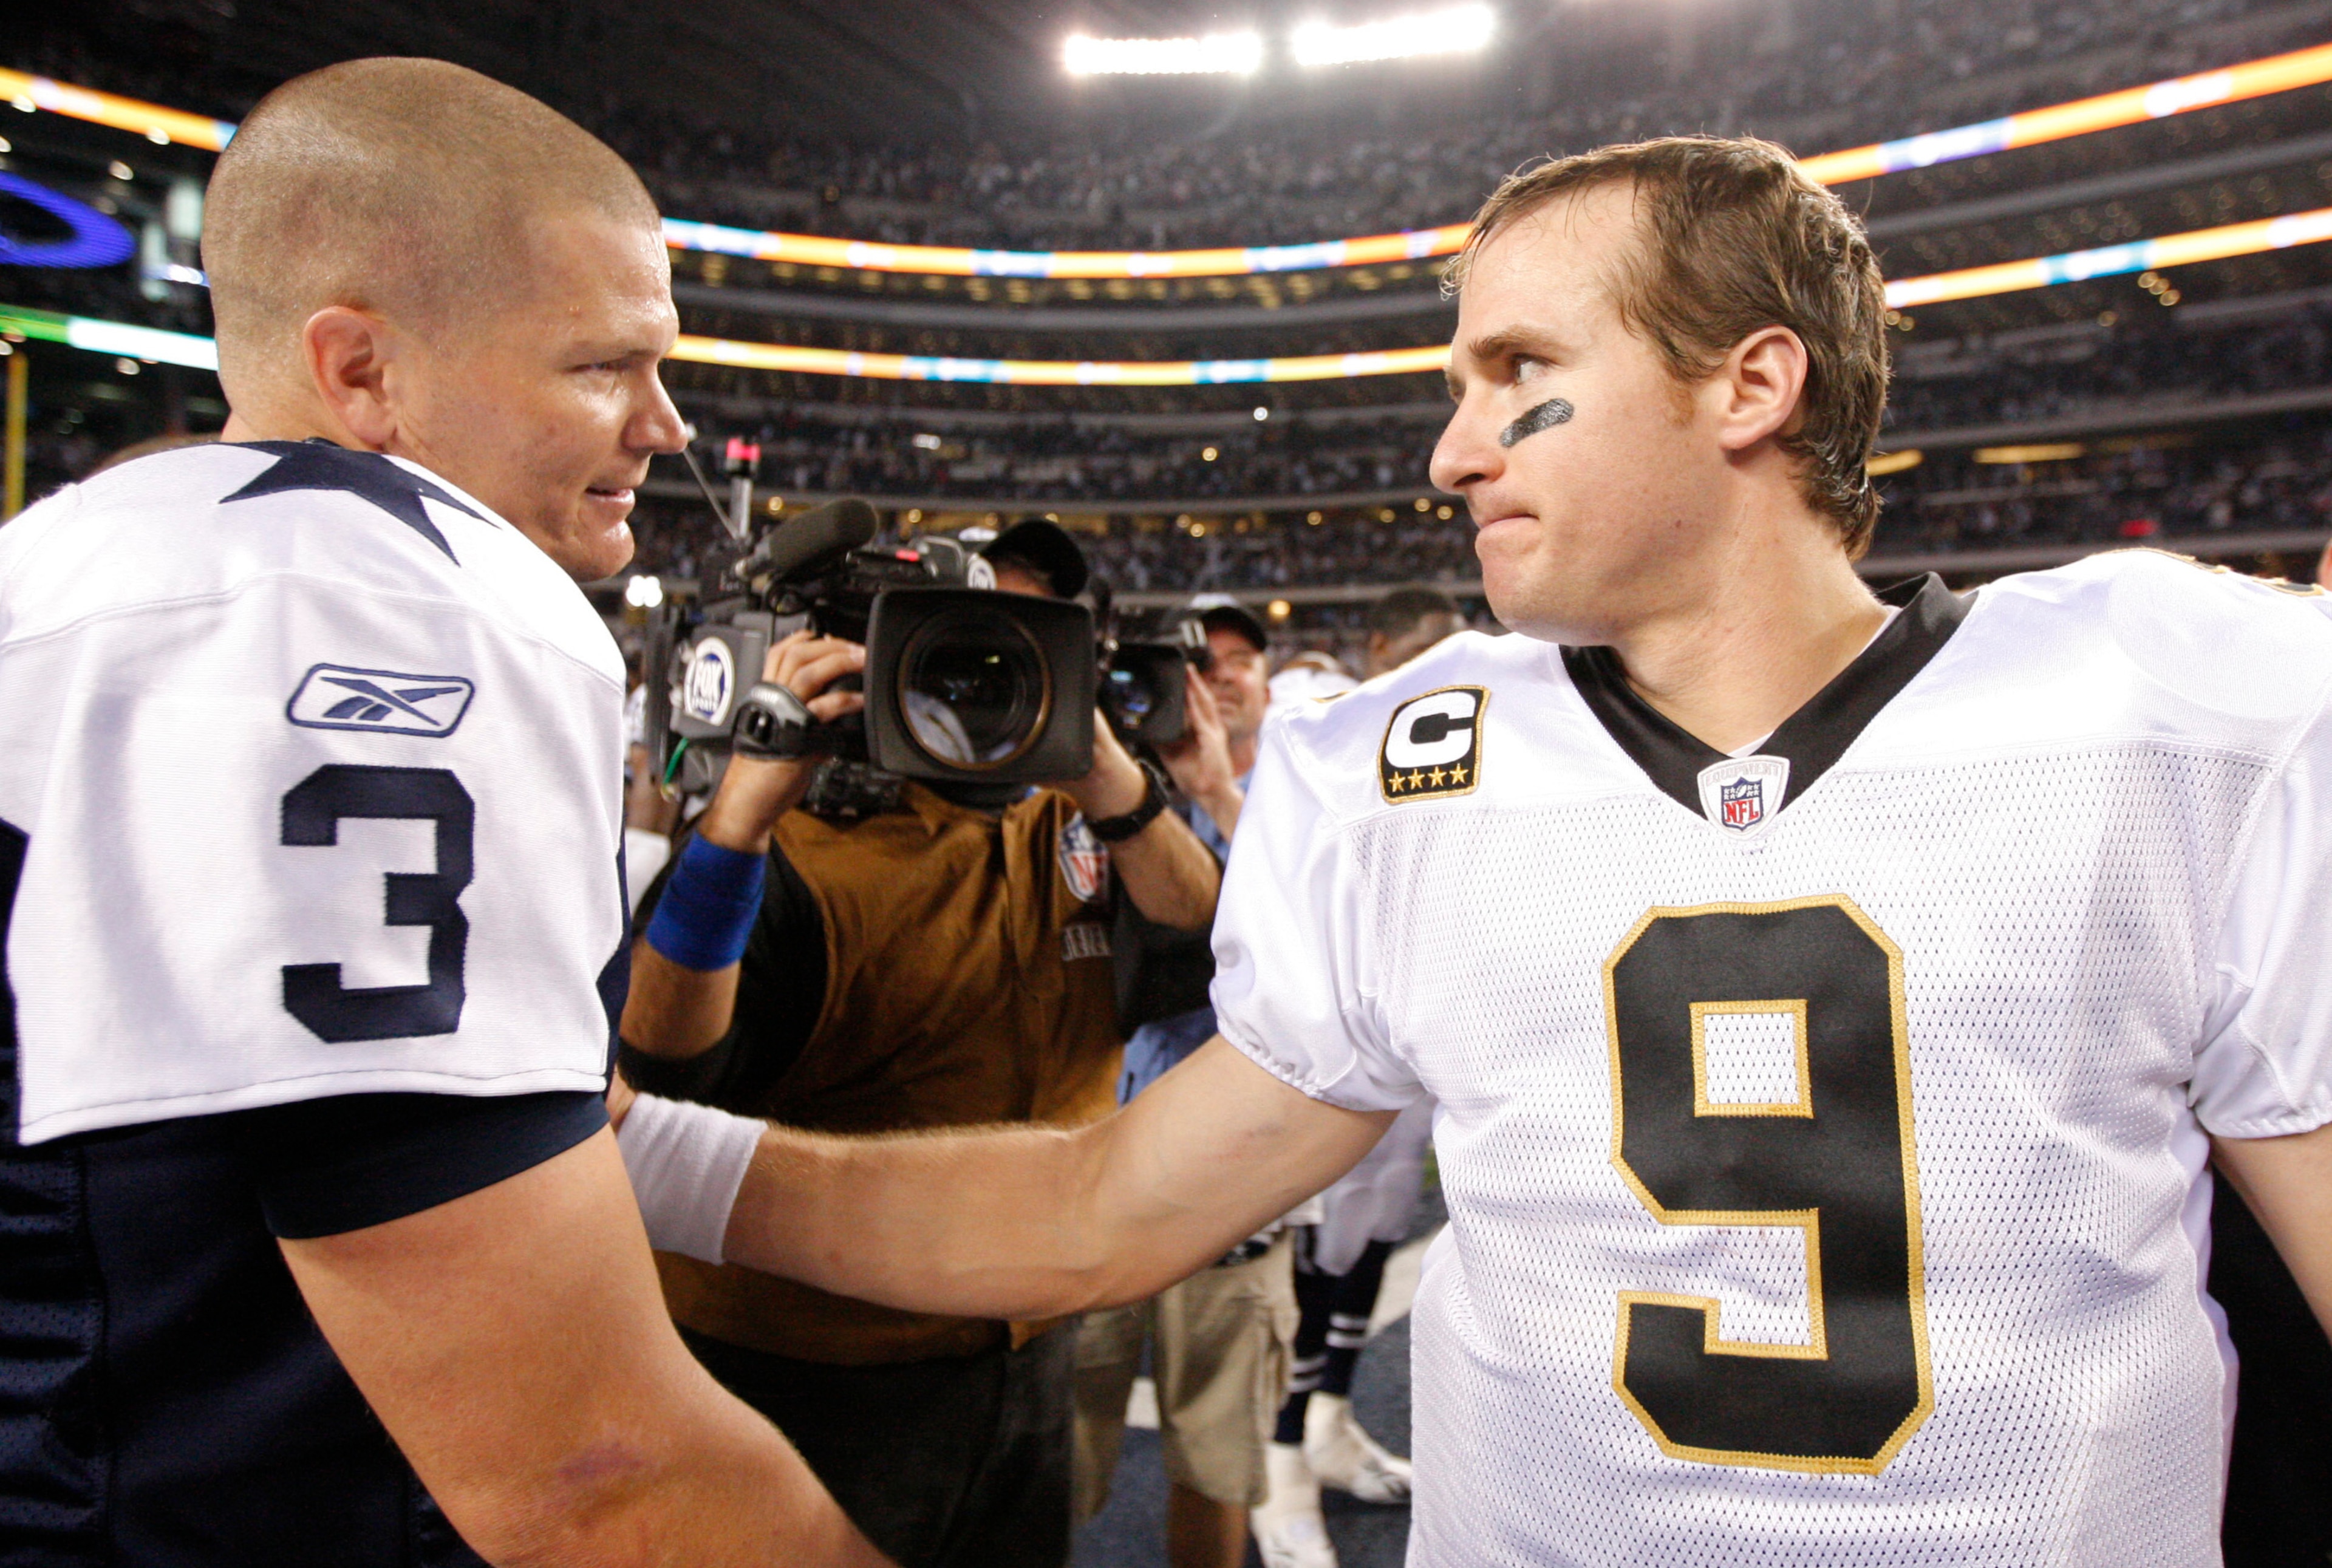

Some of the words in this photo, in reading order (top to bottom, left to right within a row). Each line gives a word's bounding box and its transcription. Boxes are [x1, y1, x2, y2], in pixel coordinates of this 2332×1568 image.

[693, 660, 723, 699] FOX
[1385, 691, 1476, 768] C
[1705, 762, 1781, 788] EQUIPMENT
[1723, 799, 1760, 825] NFL
[281, 763, 475, 1044] 3
[1602, 893, 1936, 1478] 9
